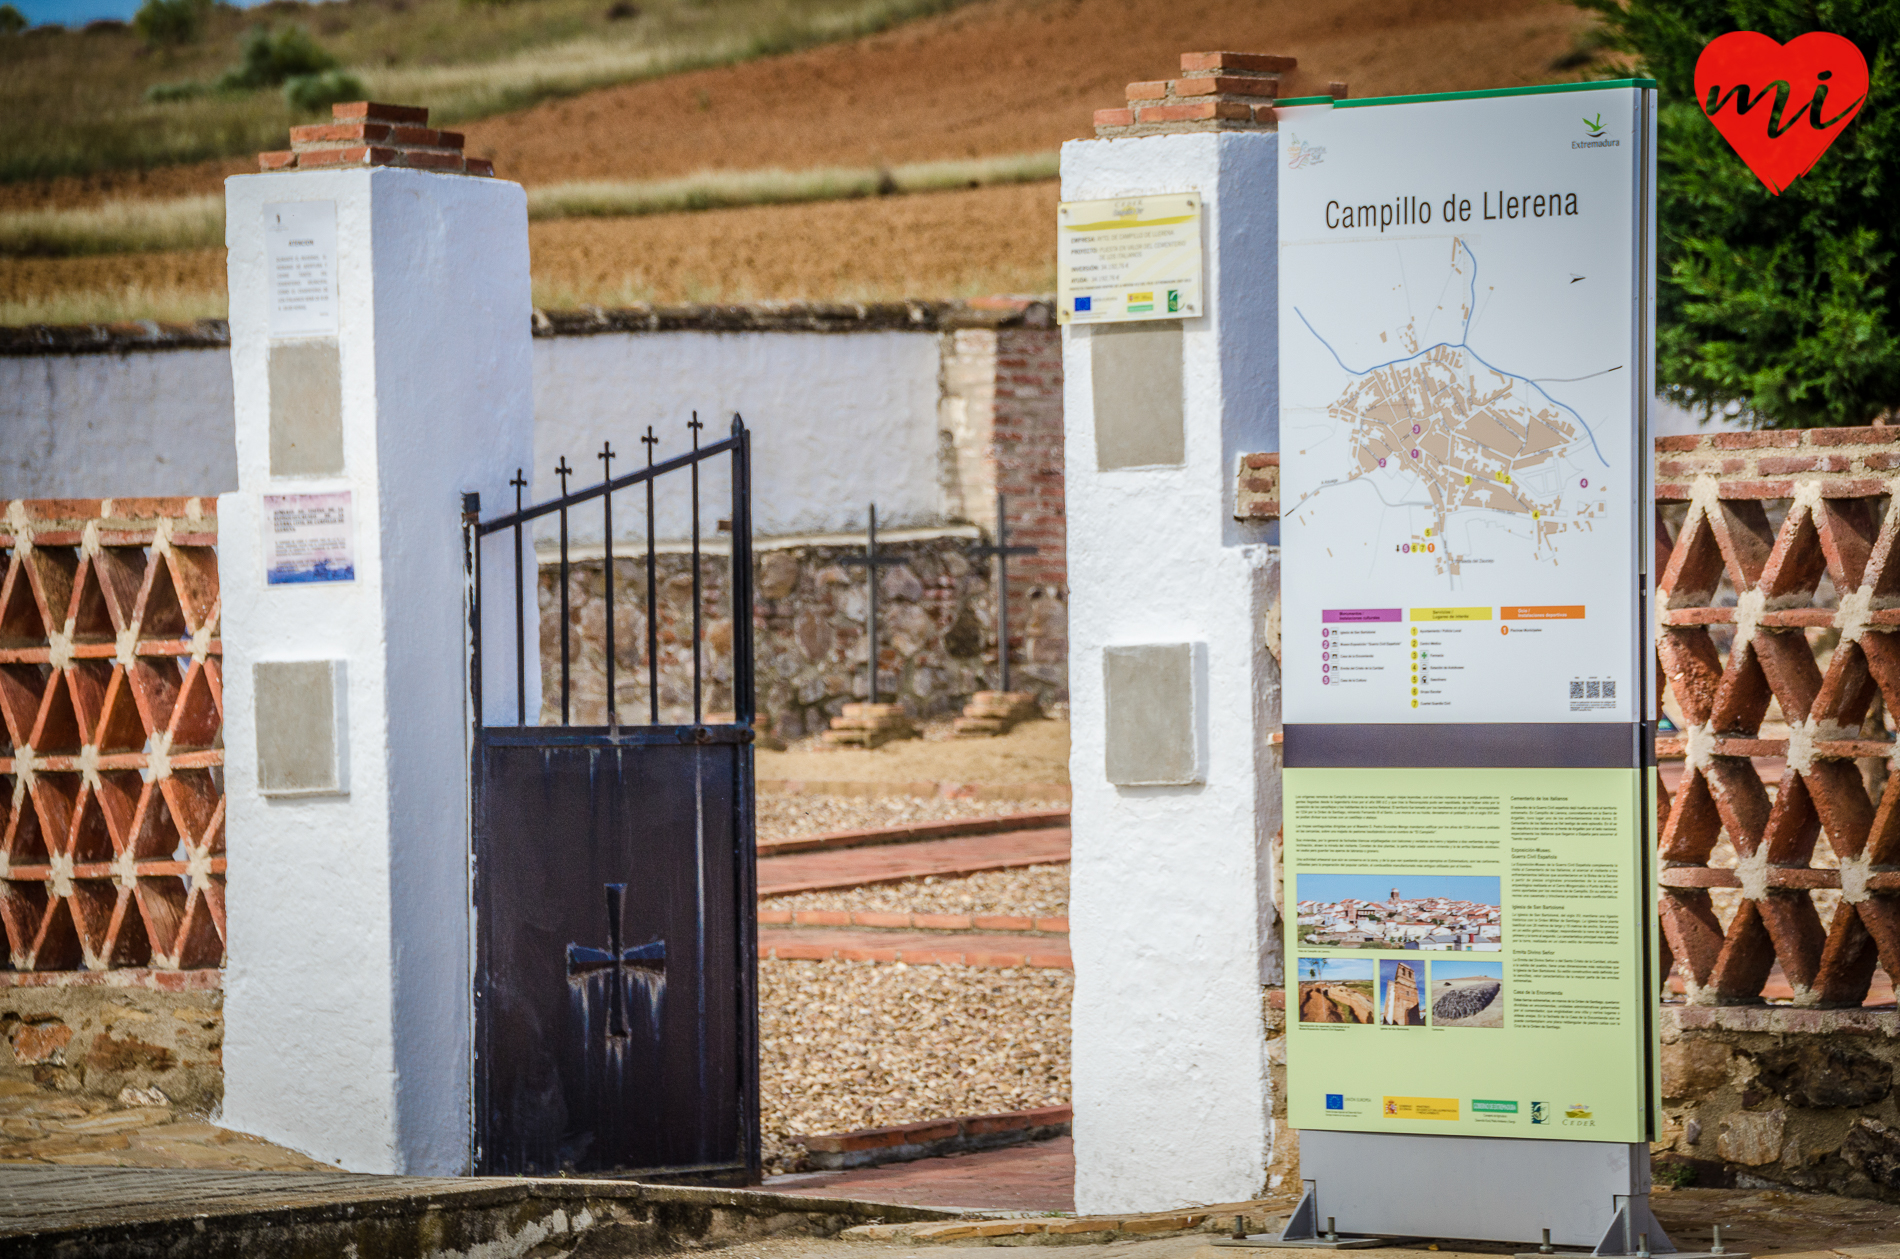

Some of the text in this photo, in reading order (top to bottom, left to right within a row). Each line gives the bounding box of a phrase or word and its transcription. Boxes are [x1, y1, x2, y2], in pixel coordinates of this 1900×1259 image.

[1572, 139, 1620, 149] Extremadura
[1326, 190, 1578, 232] Campillo de Llerena
